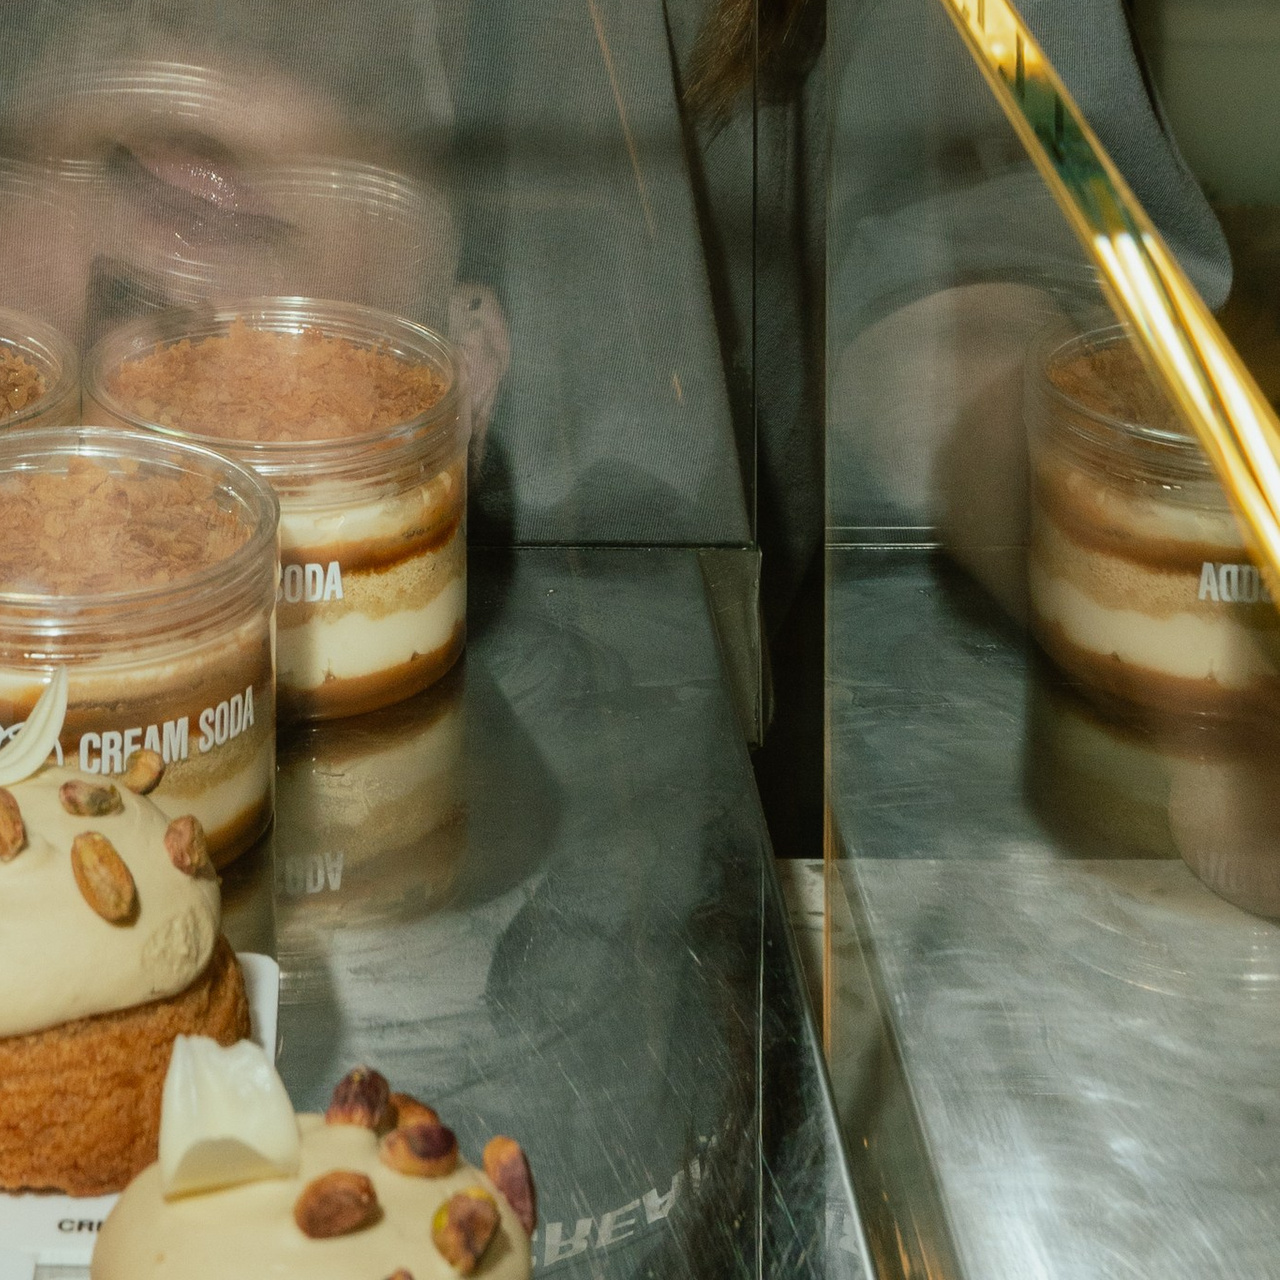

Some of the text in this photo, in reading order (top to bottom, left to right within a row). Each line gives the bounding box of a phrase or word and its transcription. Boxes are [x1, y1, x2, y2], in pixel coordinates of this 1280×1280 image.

[276, 560, 344, 604] ODA
[79, 684, 255, 775] CREAM SODA
